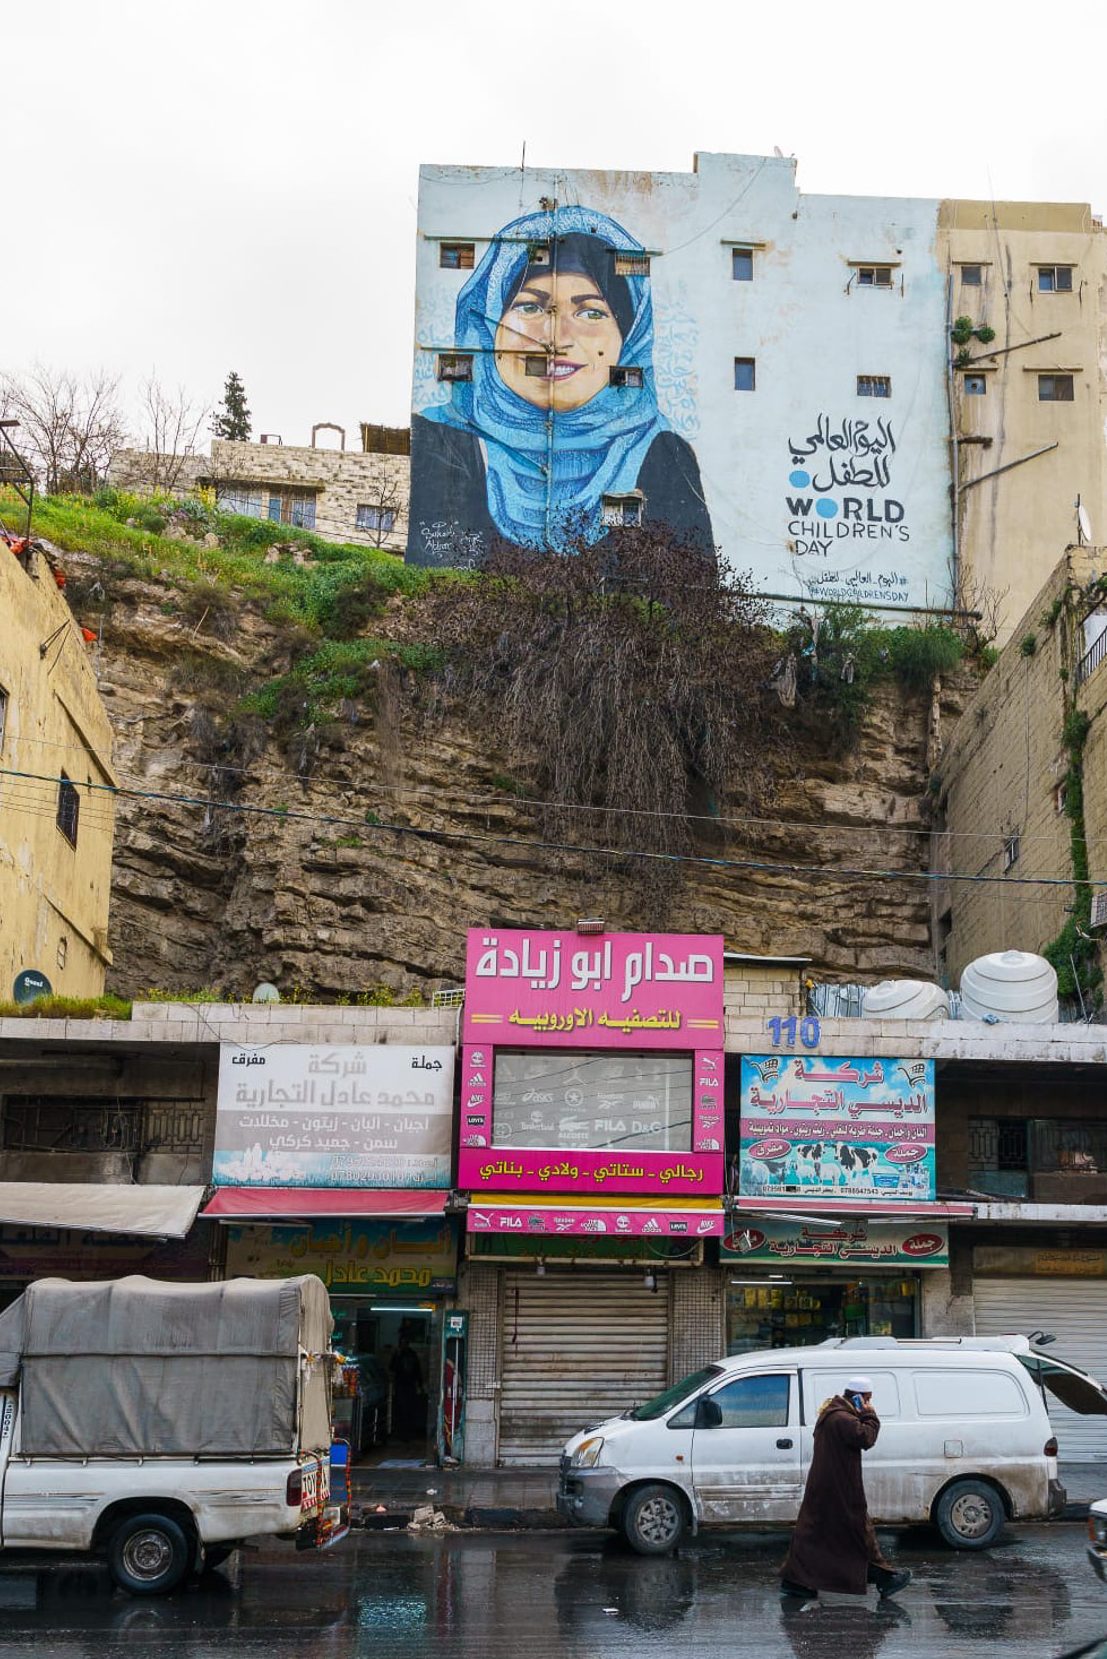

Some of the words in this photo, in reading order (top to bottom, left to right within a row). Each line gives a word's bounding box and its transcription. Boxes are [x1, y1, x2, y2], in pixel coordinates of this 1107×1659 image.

[812, 454, 890, 492] للطفل
[785, 497, 905, 523] WORLD
[788, 520, 910, 542] CHILDREN'S
[795, 540, 833, 557] DAY
[475, 937, 561, 990] زيادة
[571, 940, 612, 991] ابو
[620, 941, 714, 1003] صدام
[508, 1007, 594, 1032] الاوروبيه
[597, 1008, 681, 1034] للتصفيه
[768, 1015, 821, 1049] 110
[231, 1053, 266, 1067] مفرق
[308, 1051, 368, 1078] شركة
[411, 1055, 443, 1072] جملة
[698, 1077, 719, 1087] FILA
[794, 1059, 885, 1089] شركة
[235, 1079, 316, 1108] التجارية
[320, 1080, 371, 1106] عادل
[376, 1089, 435, 1107] محمد
[750, 1087, 845, 1116] التجارية
[239, 1114, 290, 1128] مخللات
[302, 1117, 339, 1132] زيتون
[350, 1116, 381, 1131] البان
[594, 1119, 627, 1131] FILA
[269, 1133, 312, 1151] كركي
[315, 1136, 351, 1150] جميد
[363, 1137, 398, 1151] سمن
[479, 1160, 523, 1181] بناتي
[538, 1162, 579, 1182] ولادي
[593, 1162, 644, 1182] ستاتي
[659, 1164, 704, 1184] رجالي
[500, 1216, 522, 1227] FILA
[769, 1239, 839, 1257] التجارية
[908, 1239, 936, 1250] جملة
